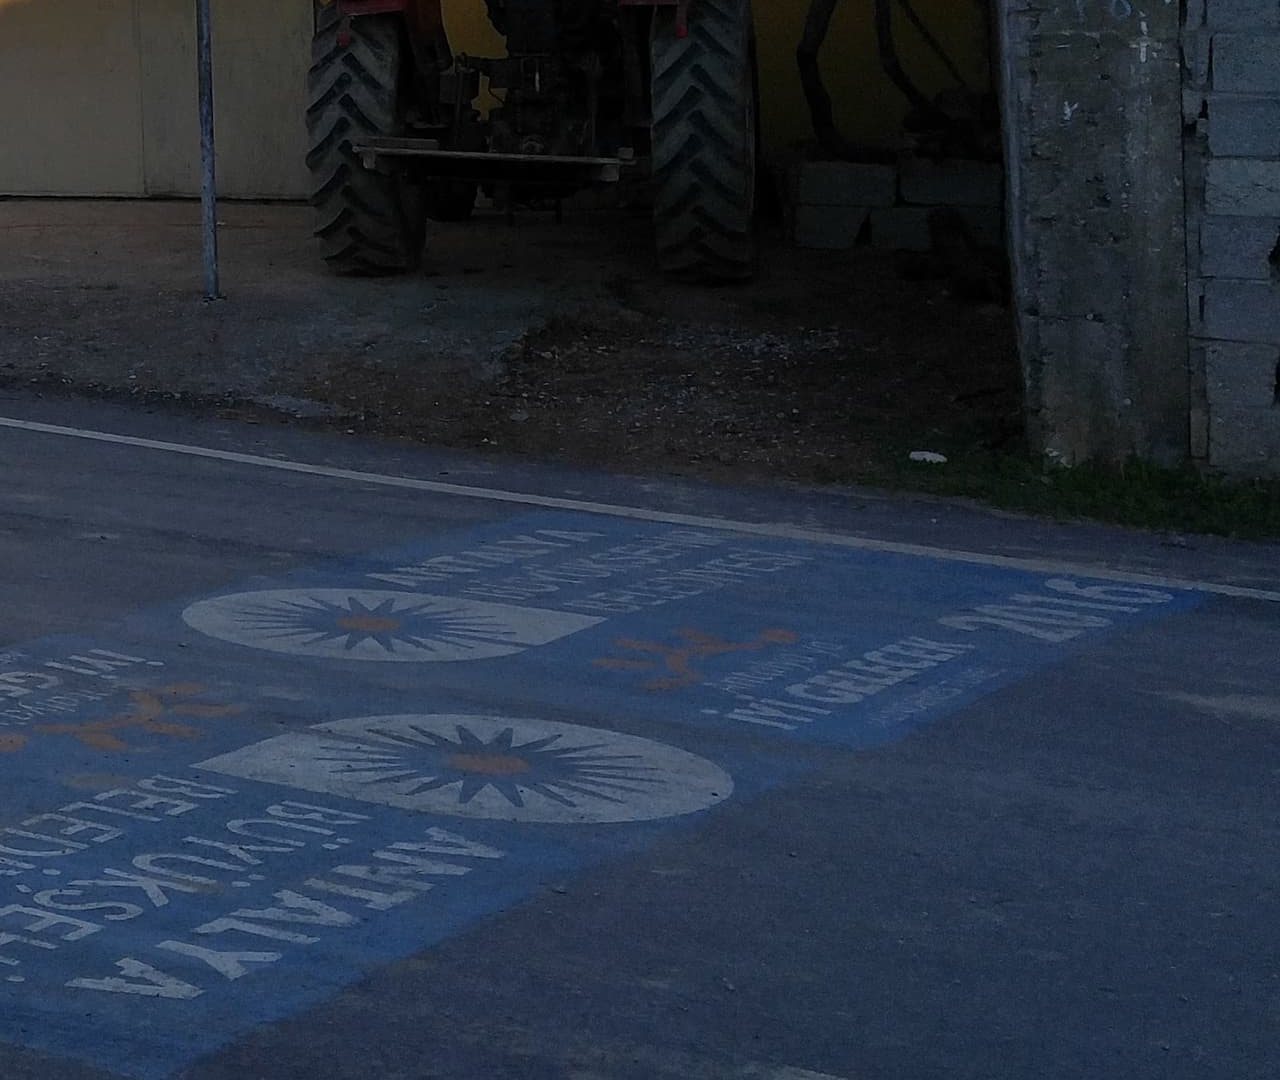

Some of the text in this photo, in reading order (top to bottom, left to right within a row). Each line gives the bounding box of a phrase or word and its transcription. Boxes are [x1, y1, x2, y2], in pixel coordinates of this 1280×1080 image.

[365, 529, 609, 587] ANTALYA
[939, 577, 1174, 643] 2016
[785, 636, 975, 704] GELECEK
[65, 827, 504, 1000] ANTALYA
